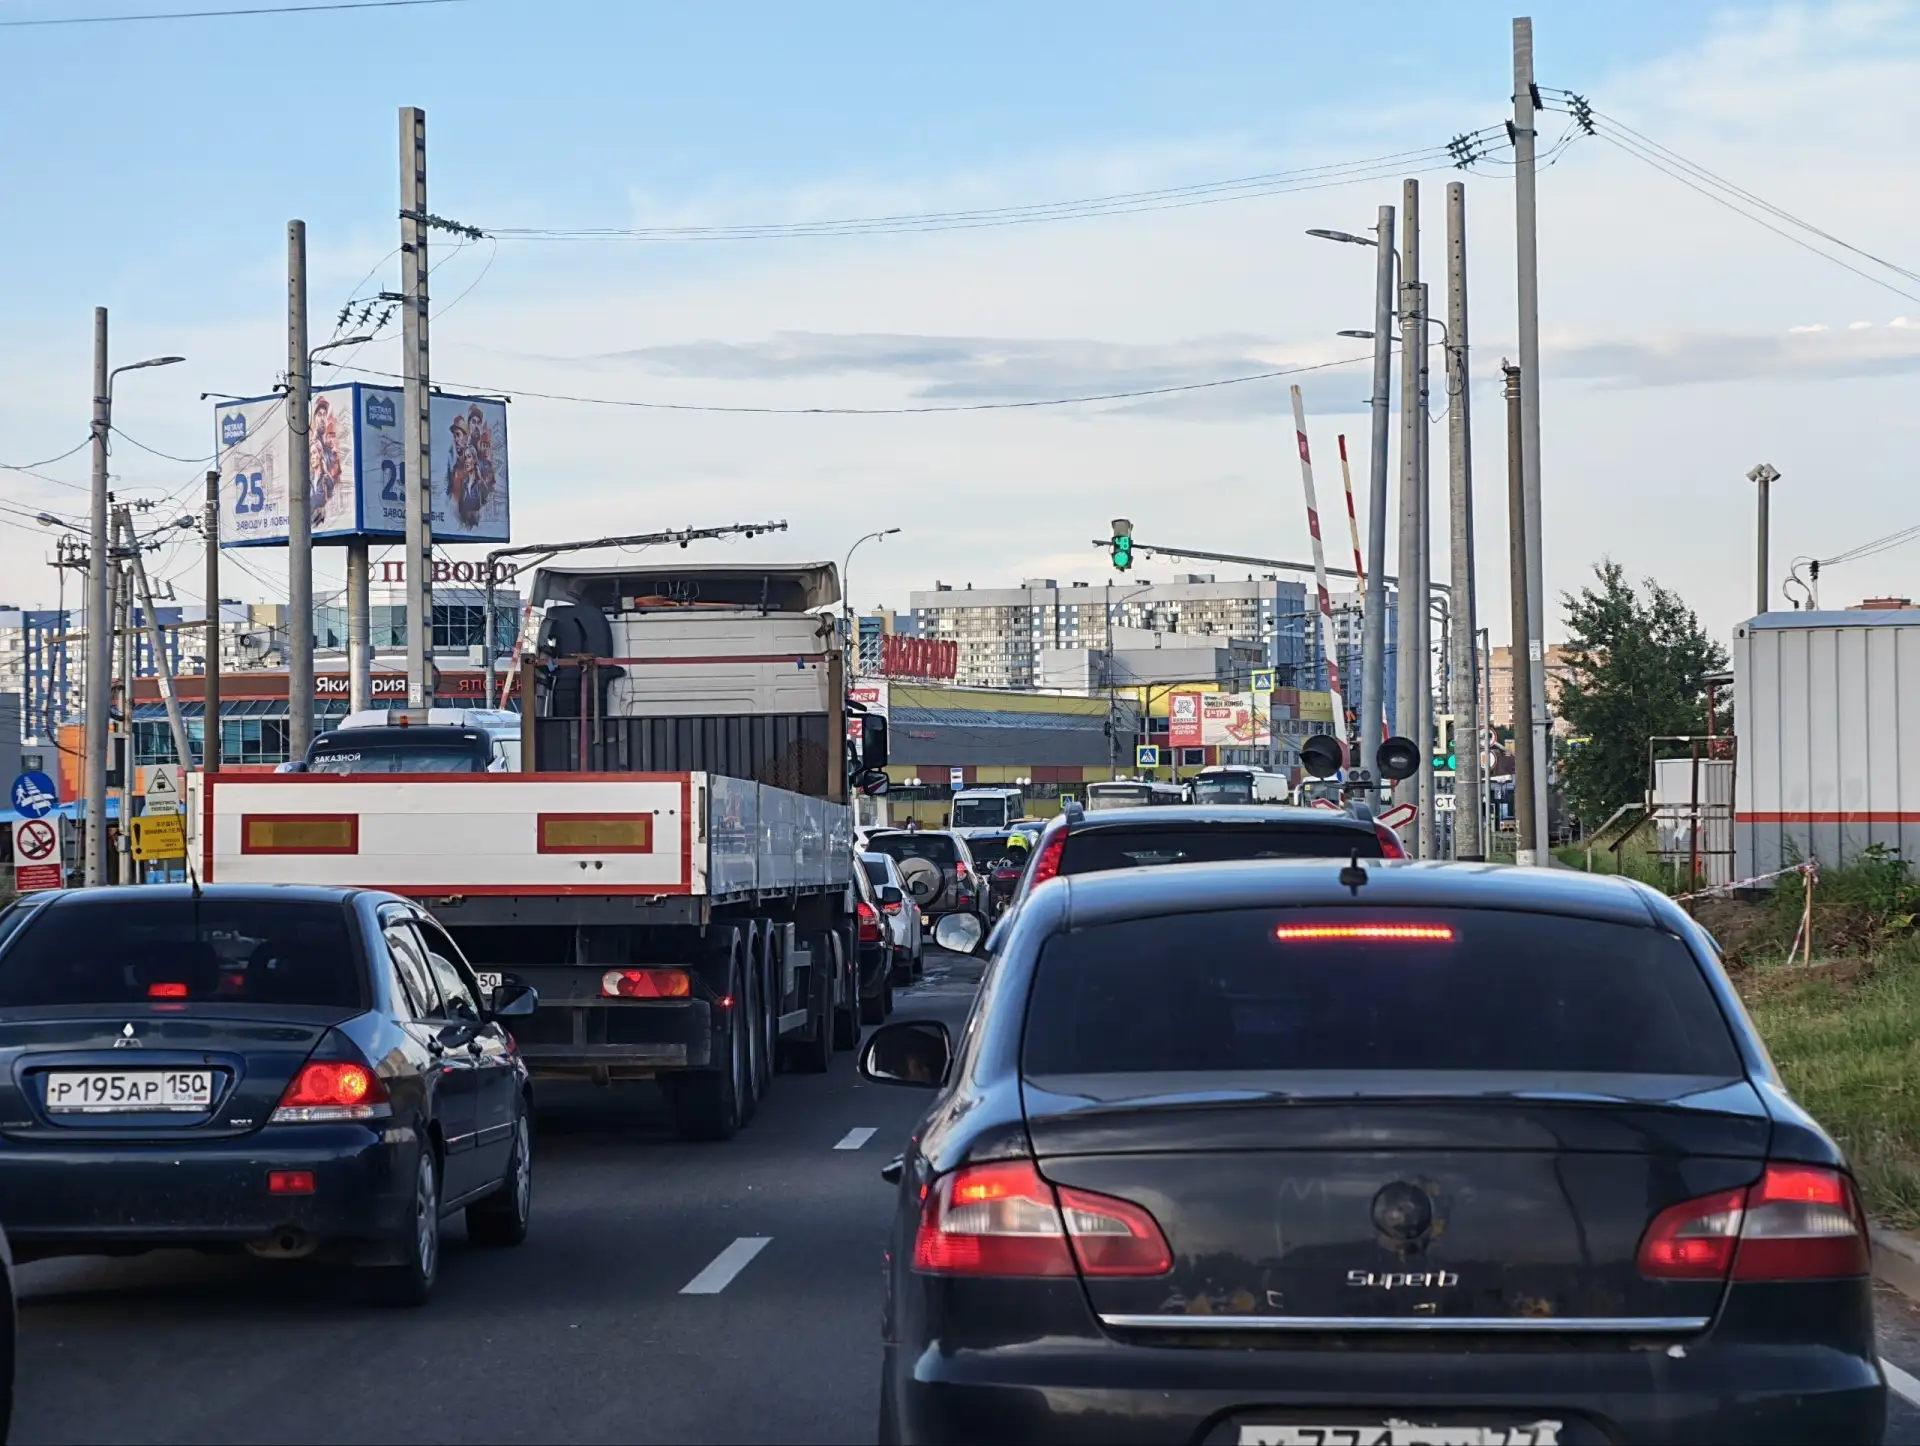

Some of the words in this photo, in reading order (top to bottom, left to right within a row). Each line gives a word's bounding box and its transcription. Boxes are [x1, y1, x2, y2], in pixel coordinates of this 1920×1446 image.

[235, 472, 265, 514] 25
[236, 519, 262, 531] ЗАВОДУ
[263, 518, 268, 528] В
[382, 561, 518, 584] ПВОРОТ
[316, 677, 406, 695] Якирия
[314, 752, 361, 764] ЗАКАЗНОЙ
[1435, 797, 1457, 808] СТ
[57, 1076, 158, 1102] Р195АР
[166, 1074, 205, 1094] 150
[174, 1093, 193, 1101] RUS
[1346, 1269, 1459, 1290] Superb
